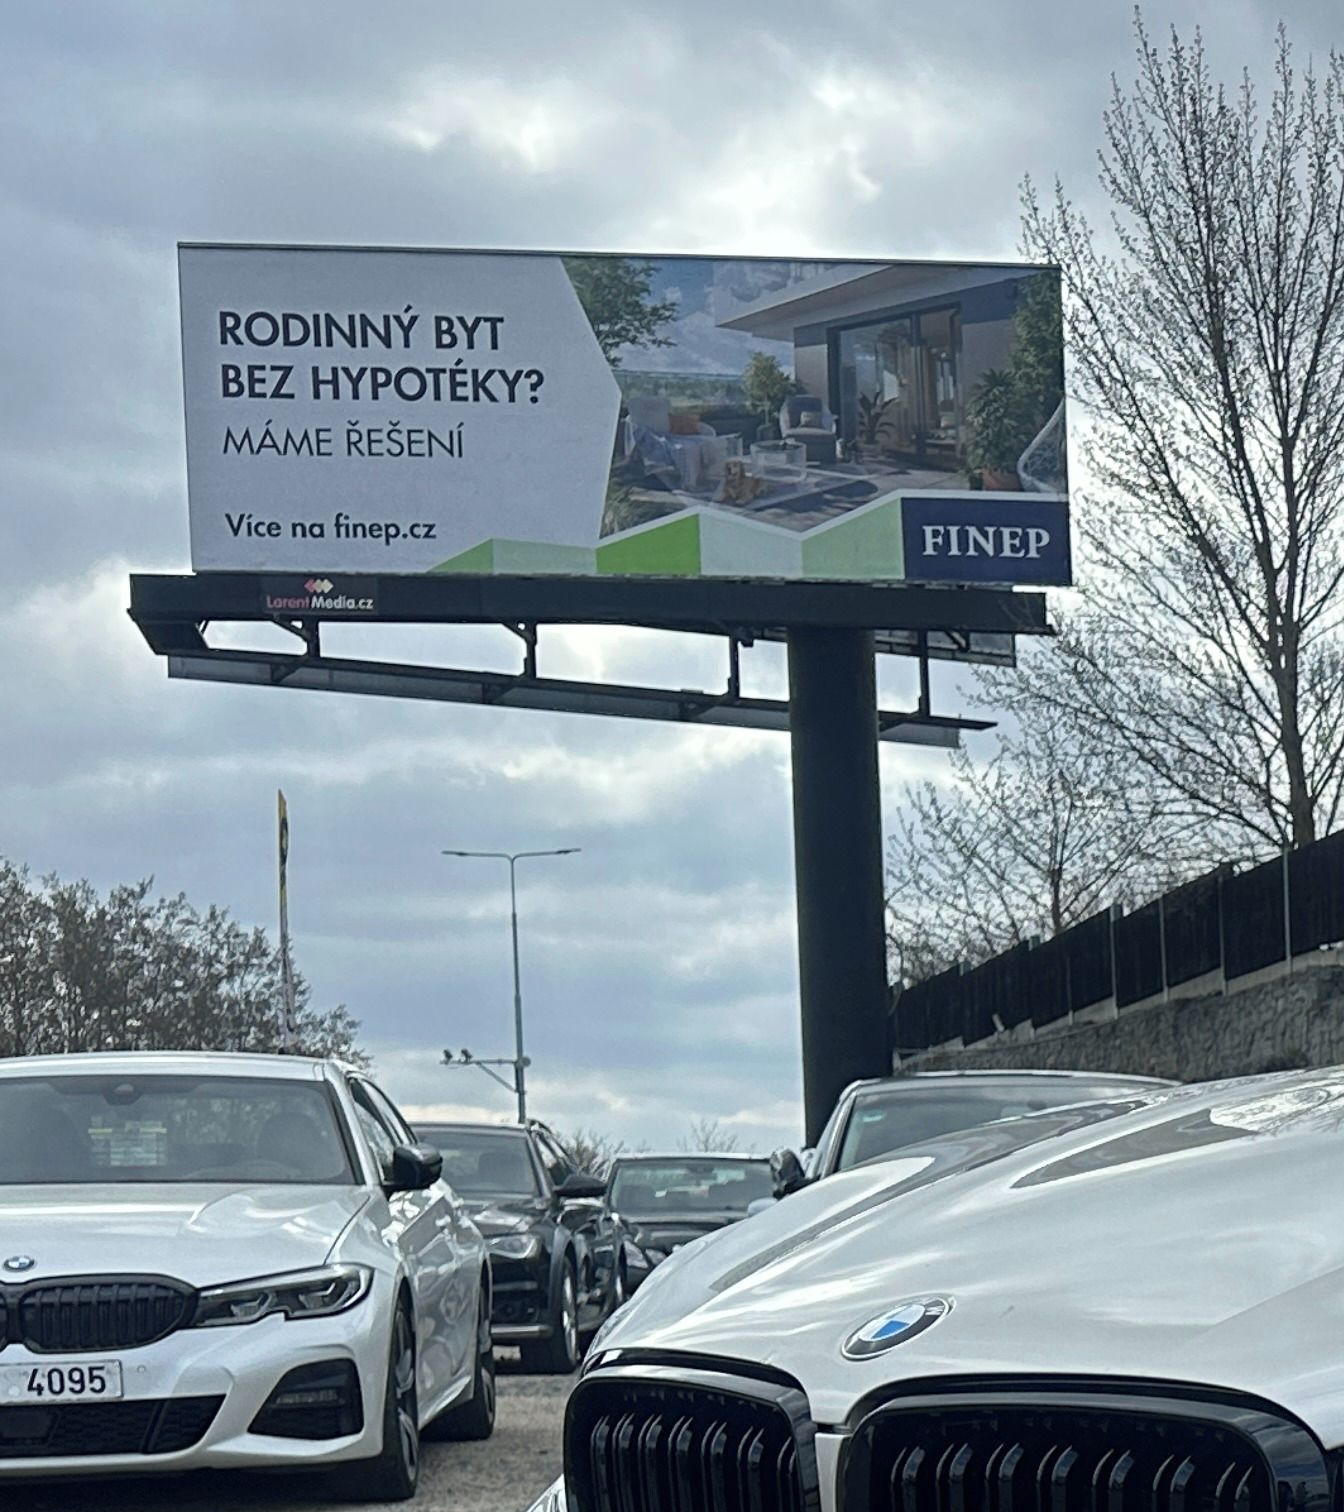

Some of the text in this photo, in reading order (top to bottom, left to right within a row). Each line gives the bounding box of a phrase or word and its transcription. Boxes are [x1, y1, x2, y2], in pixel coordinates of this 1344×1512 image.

[218, 304, 505, 352] RODINNÝ BYT
[221, 358, 545, 404] BEZ HYPOTÉKY?
[222, 419, 463, 460] MÁME ŘEŠENÍ
[225, 513, 437, 546] Více na finep.cz
[922, 524, 1050, 559] FINEP
[27, 1366, 107, 1396] 4095
